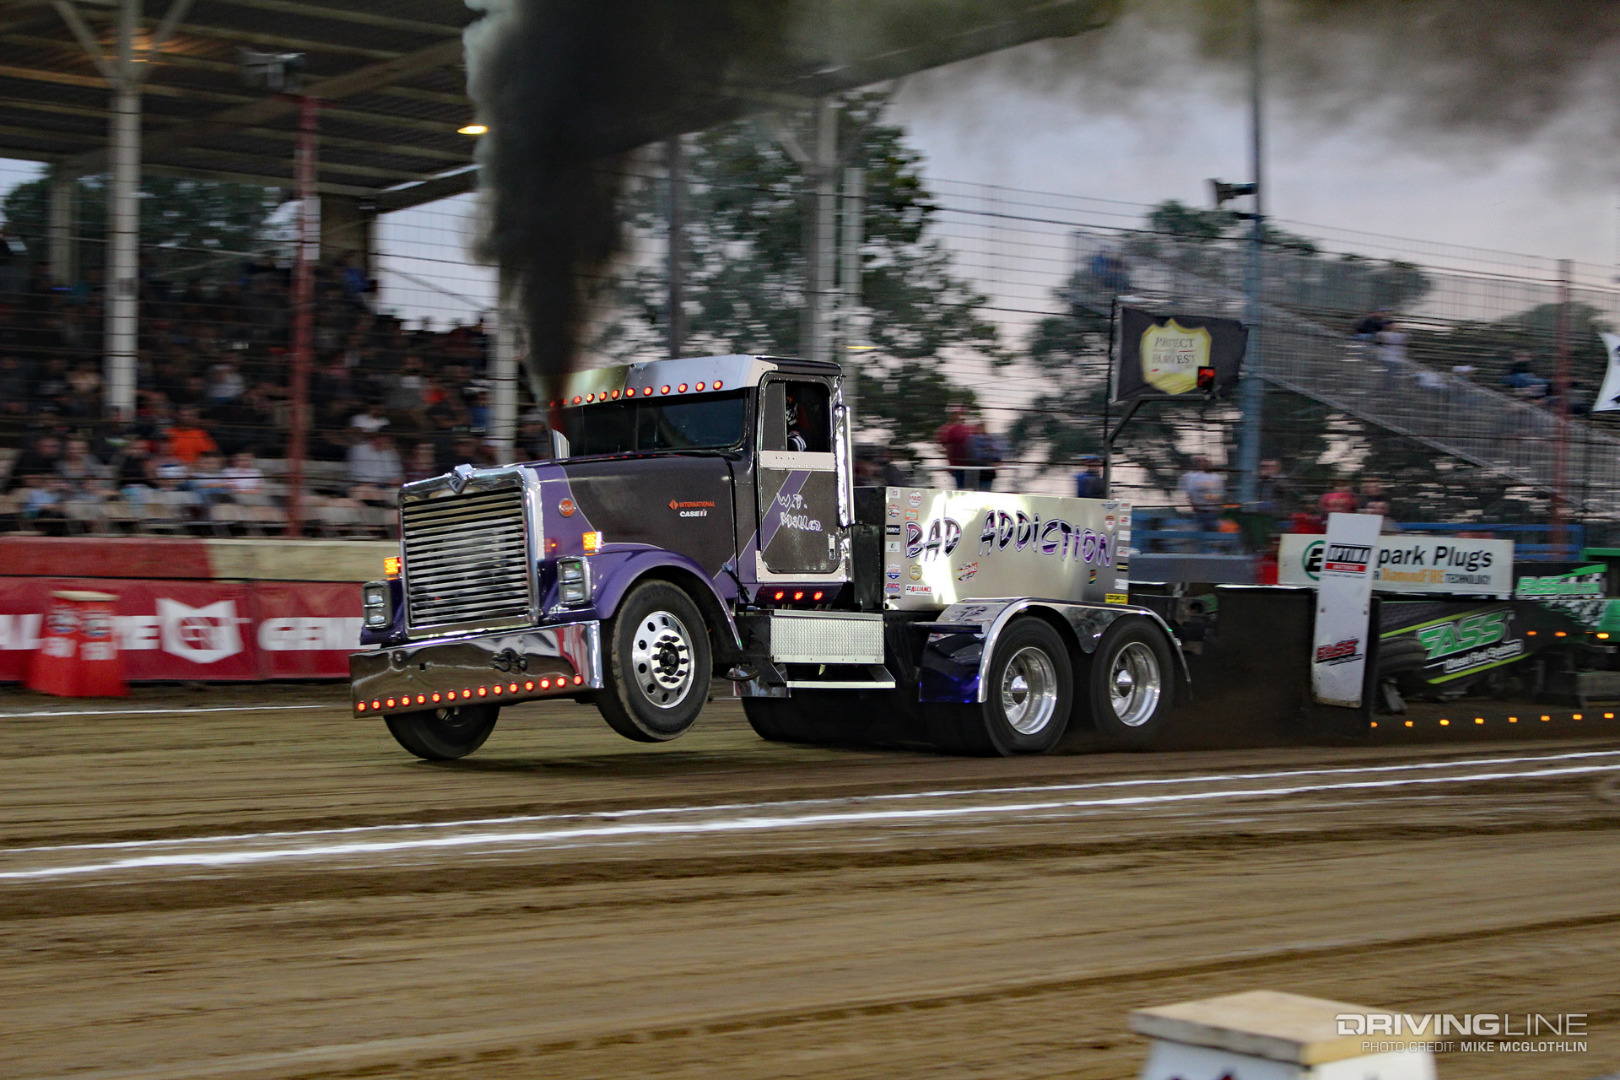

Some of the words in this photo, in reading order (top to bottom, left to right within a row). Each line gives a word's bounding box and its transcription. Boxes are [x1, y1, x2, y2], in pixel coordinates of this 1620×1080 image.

[906, 517, 962, 562] BAD
[978, 510, 1117, 567] ADDICTION
[1325, 546, 1371, 563] OPTIMA
[1375, 545, 1427, 568] park
[1433, 545, 1494, 572] Plugs
[1416, 610, 1508, 660] FASS
